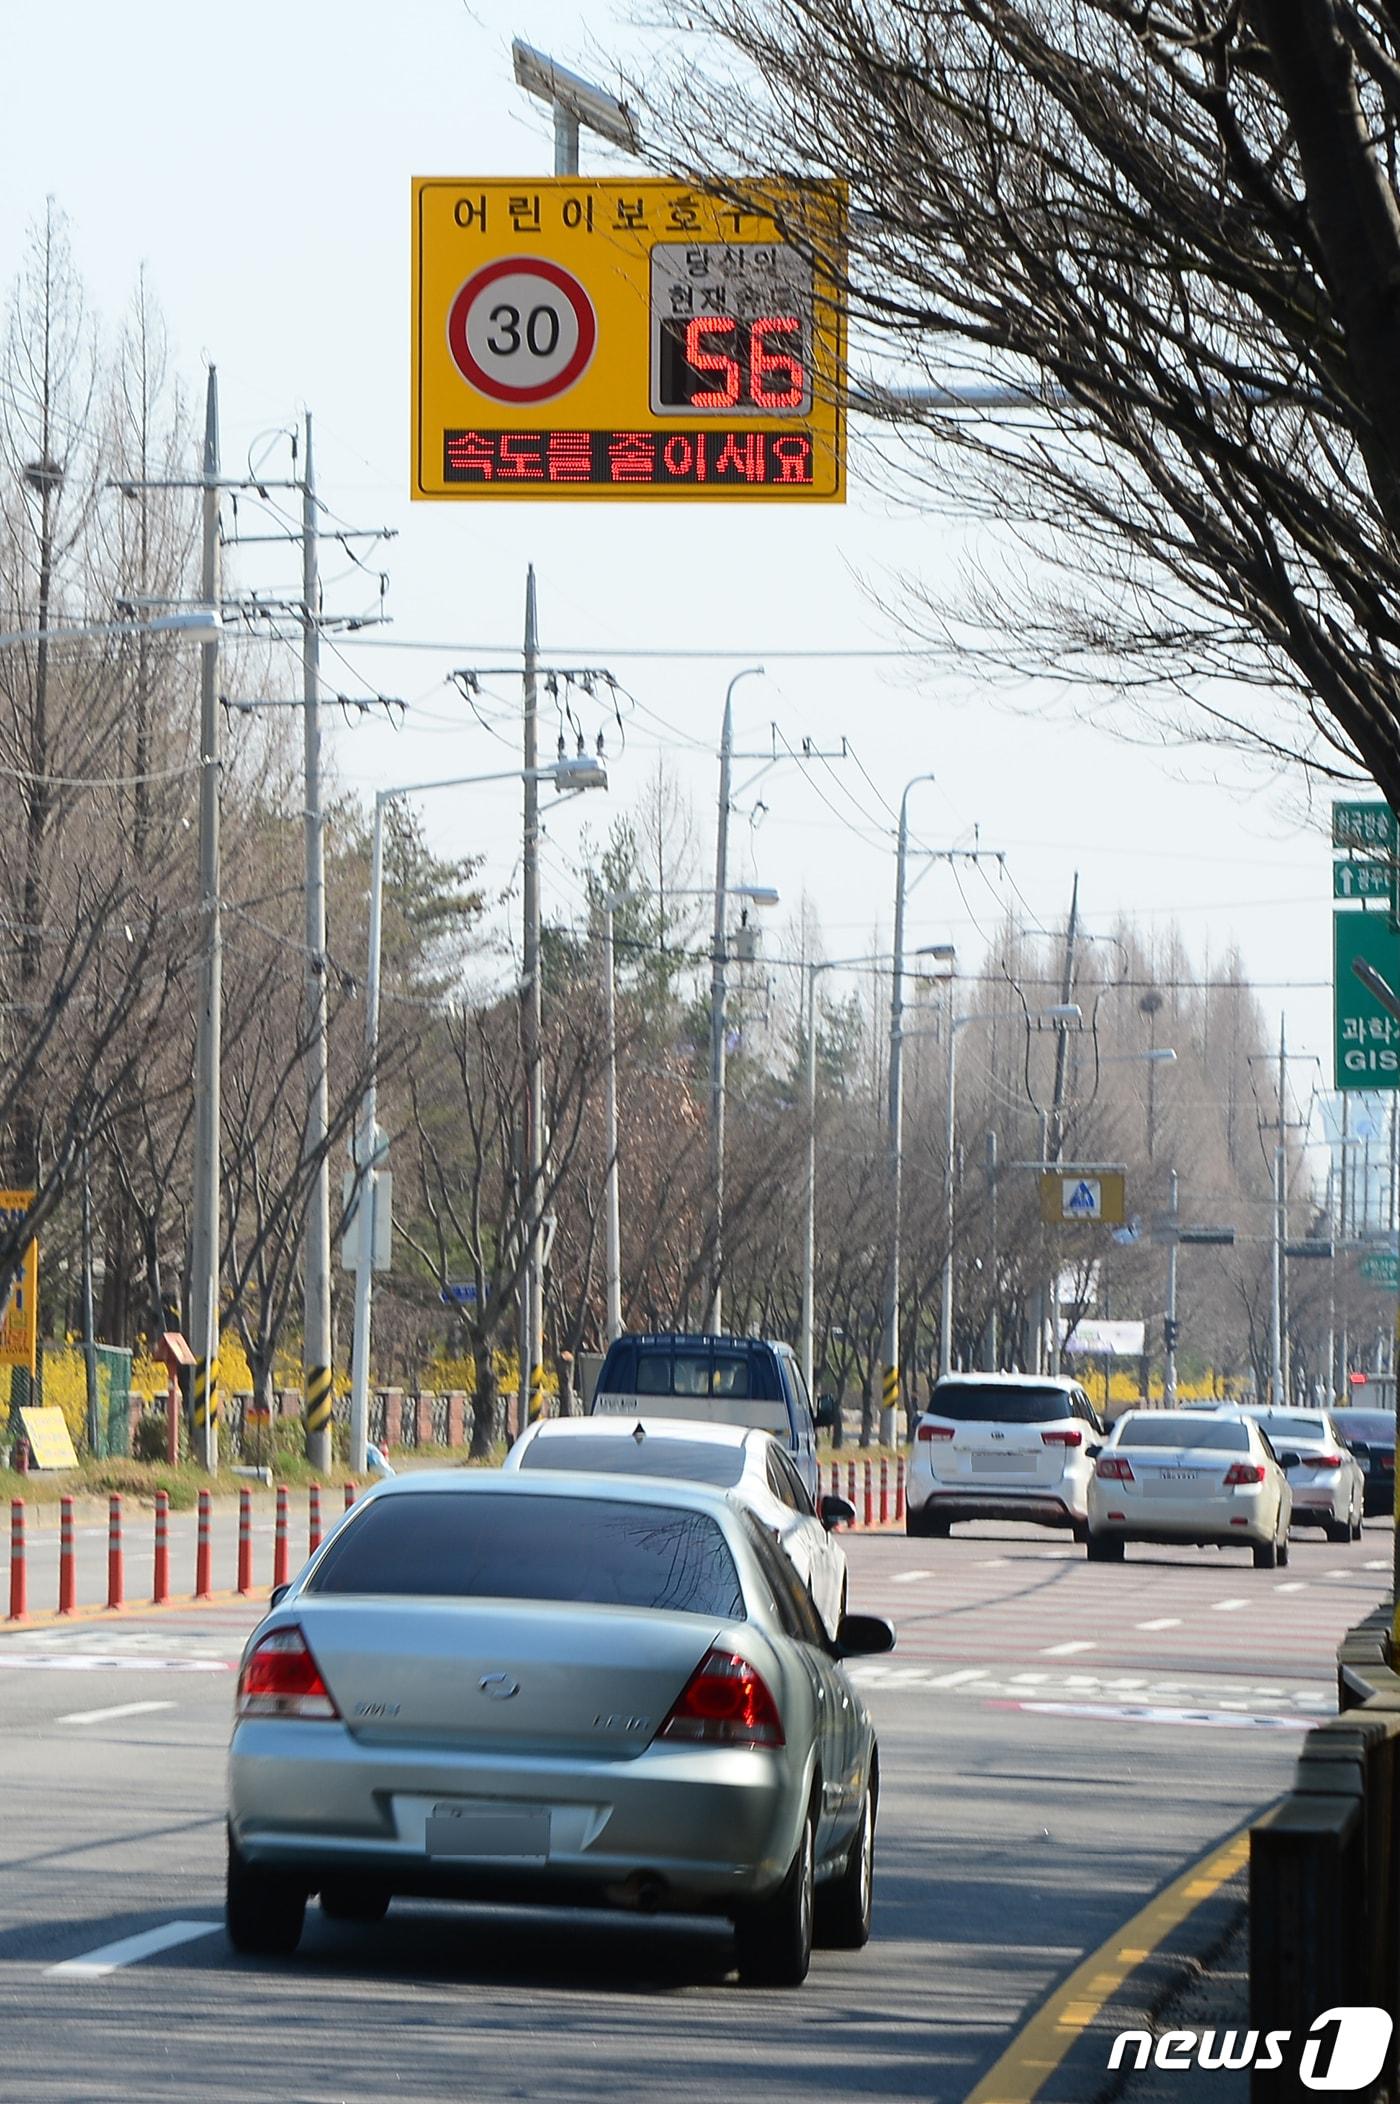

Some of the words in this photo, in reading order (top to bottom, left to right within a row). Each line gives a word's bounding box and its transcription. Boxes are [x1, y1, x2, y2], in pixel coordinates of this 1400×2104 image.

[487, 304, 560, 358] 30
[686, 317, 804, 410] 56
[447, 432, 593, 481] 속도를
[607, 432, 814, 484] 줄이세요
